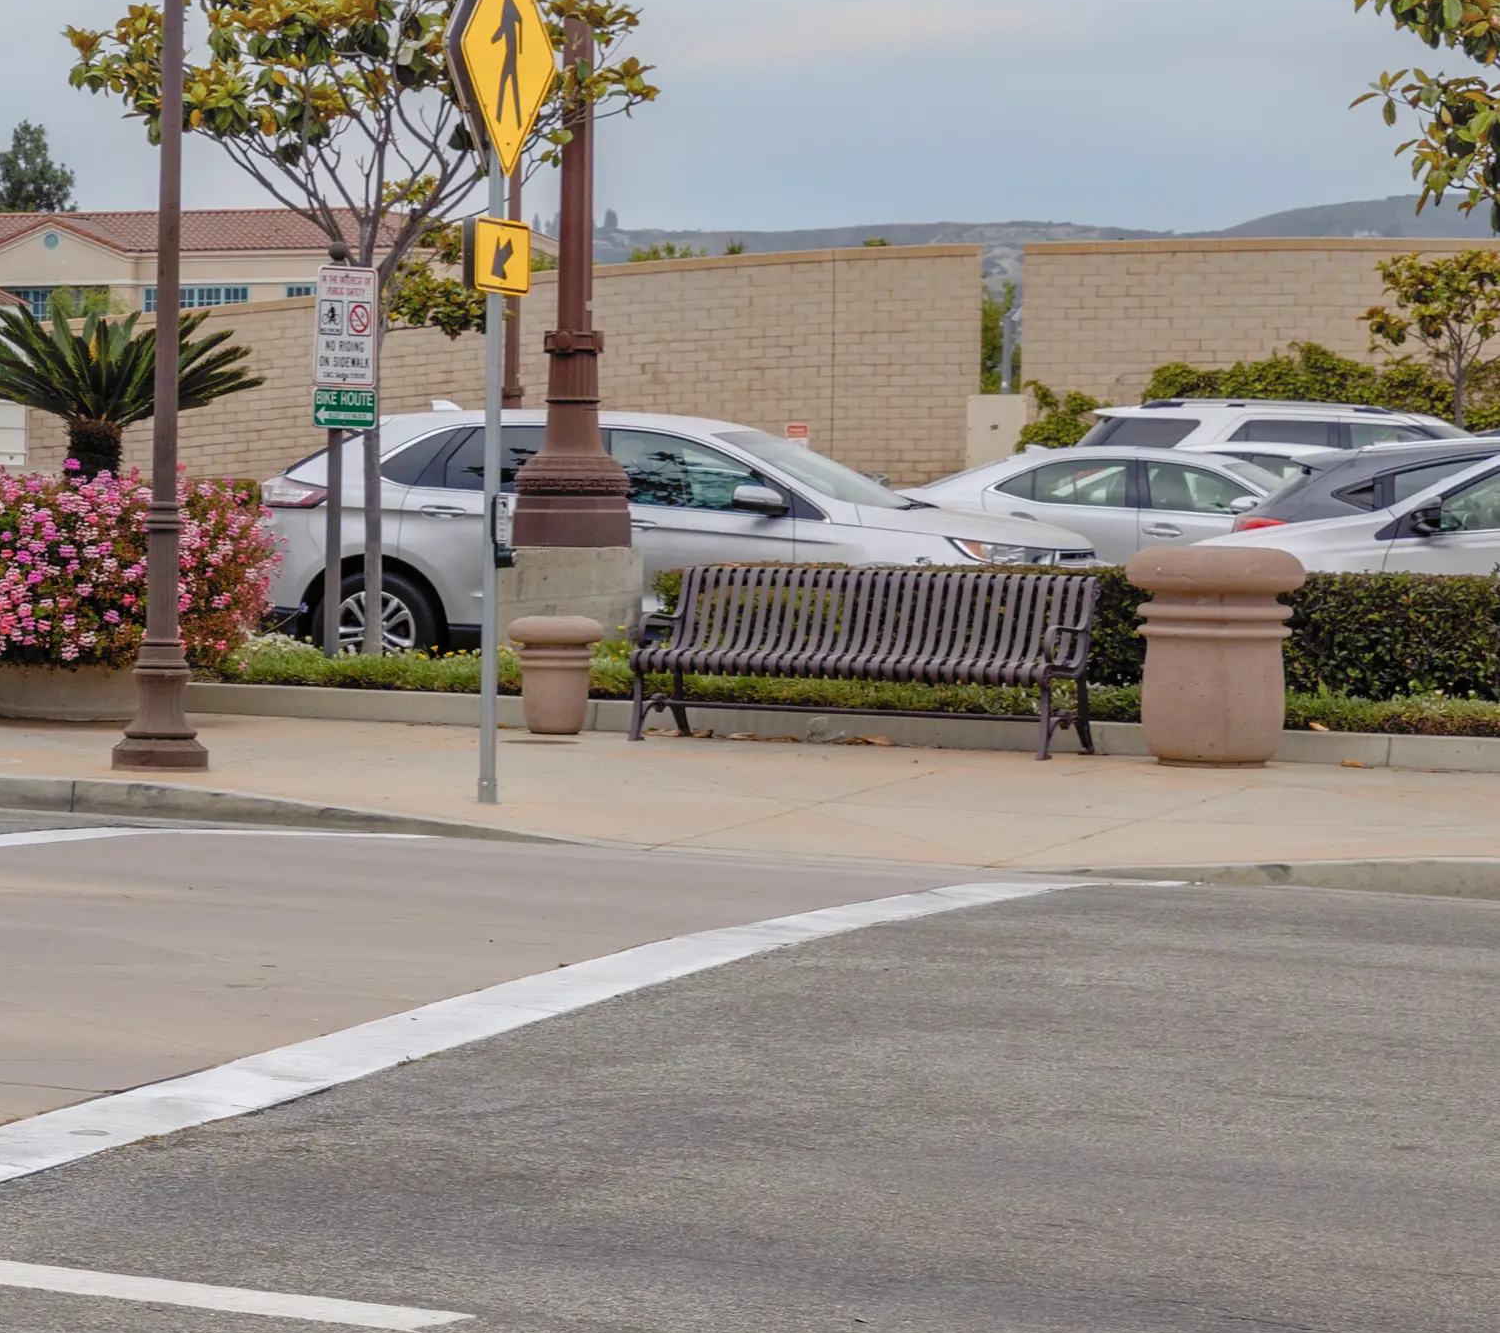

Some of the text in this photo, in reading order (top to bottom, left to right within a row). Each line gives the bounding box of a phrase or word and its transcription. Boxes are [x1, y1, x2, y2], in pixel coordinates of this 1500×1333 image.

[325, 340, 365, 353] NO RIDING
[318, 355, 370, 368] ON SIDEWALK
[316, 391, 374, 406] BIKE ROUTE
